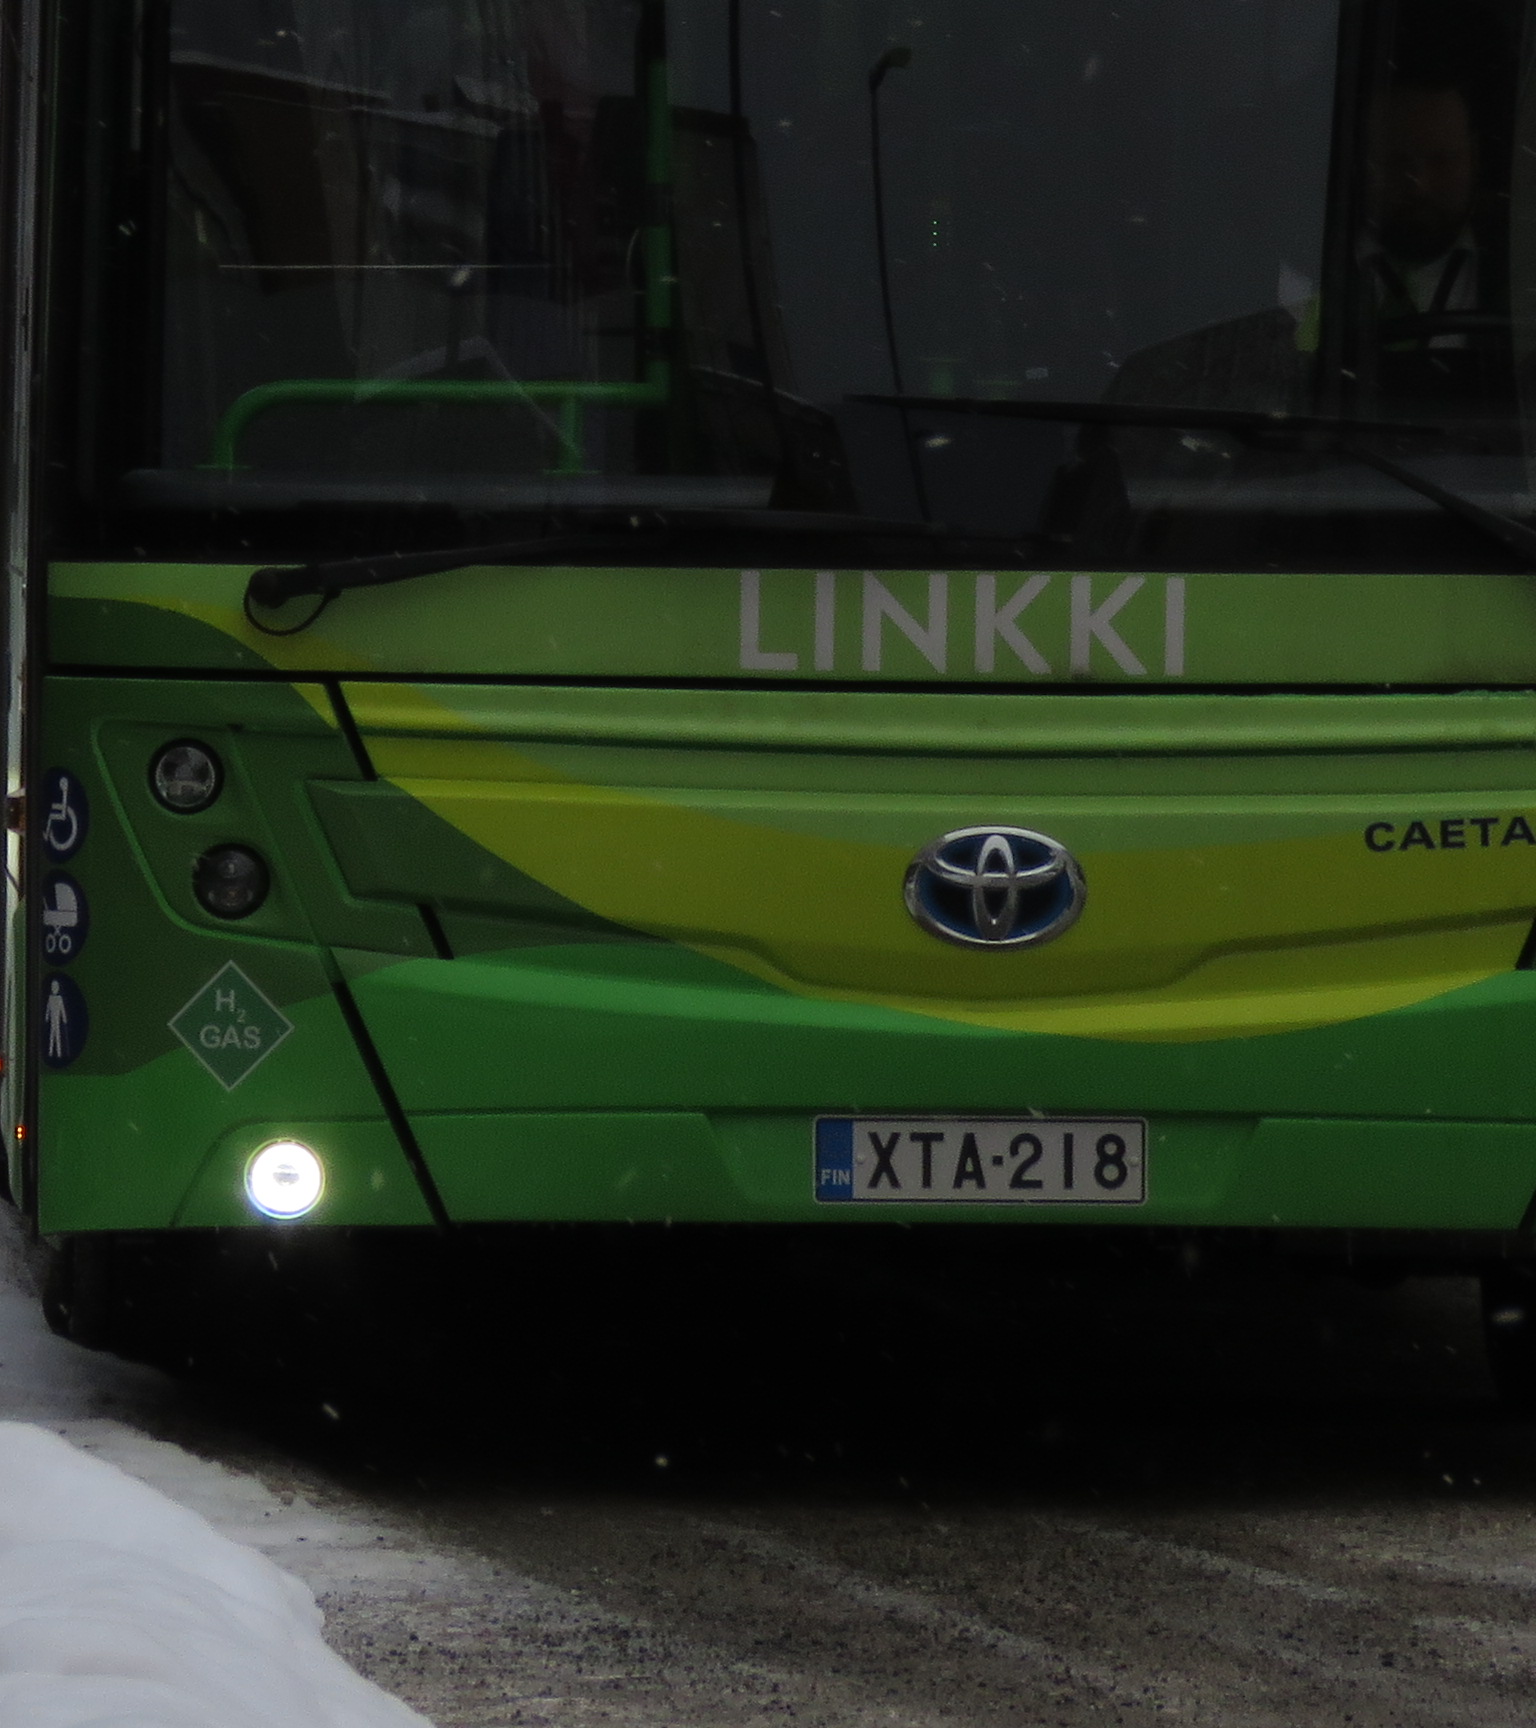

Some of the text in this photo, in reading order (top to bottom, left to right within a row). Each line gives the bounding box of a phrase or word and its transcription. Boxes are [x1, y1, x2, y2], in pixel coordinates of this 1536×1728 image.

[738, 571, 1186, 676] LINKKI
[199, 1024, 262, 1049] GAS
[820, 1131, 1129, 1190] FIN XTA-218
